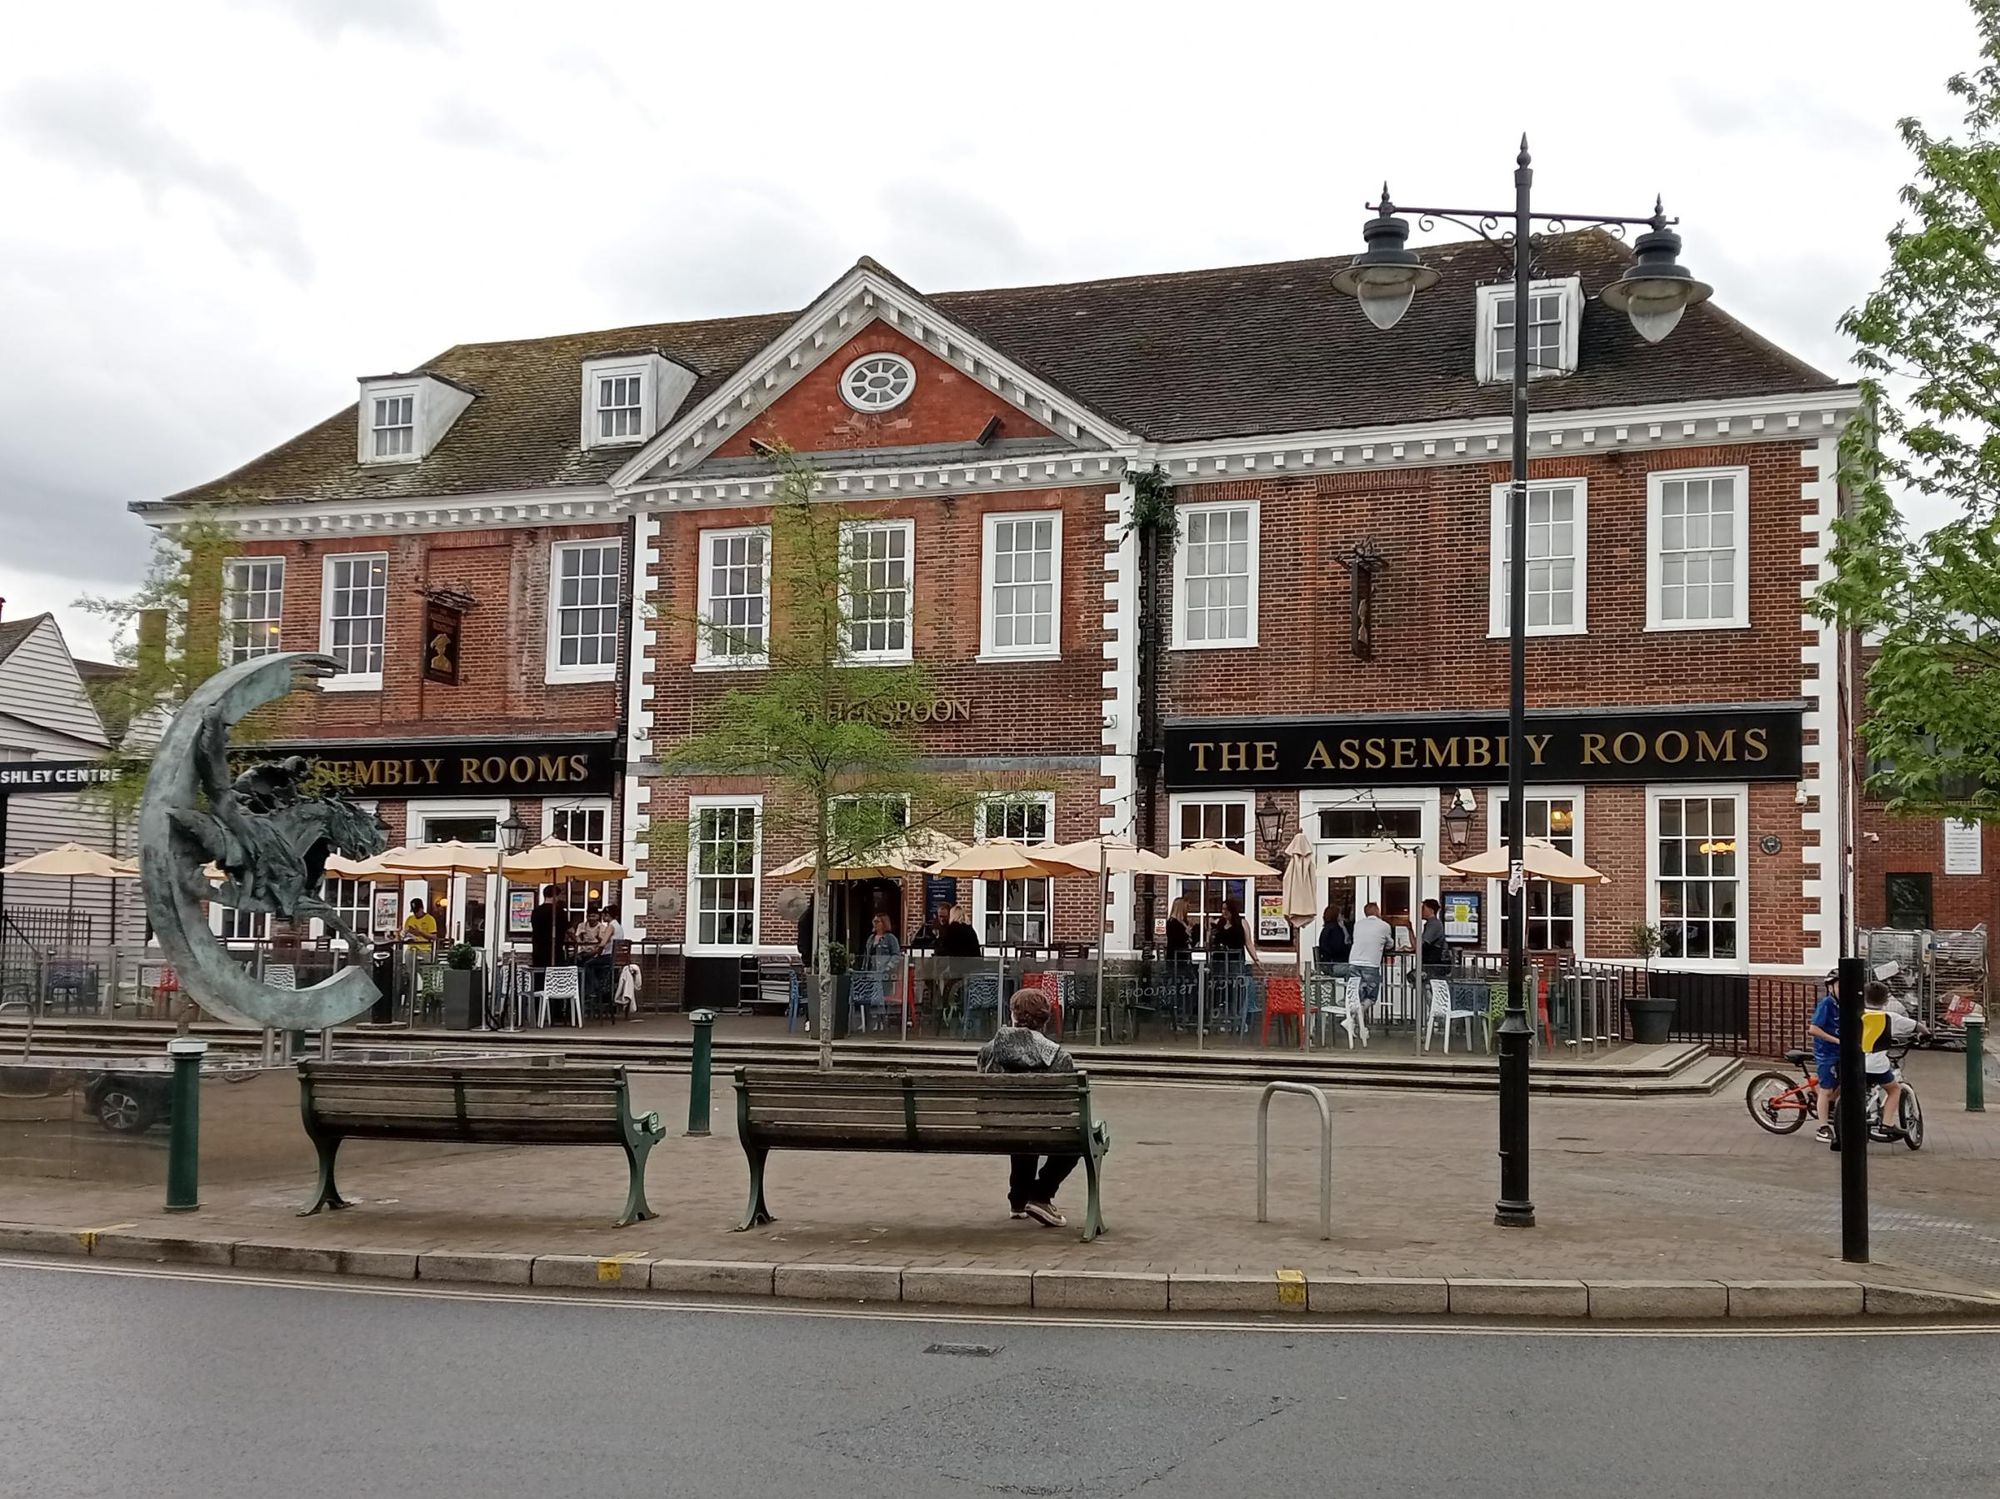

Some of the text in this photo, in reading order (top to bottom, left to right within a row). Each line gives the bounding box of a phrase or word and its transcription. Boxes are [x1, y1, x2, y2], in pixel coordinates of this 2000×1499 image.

[1189, 741, 1279, 772] THE
[1580, 728, 1769, 766] ROOMS
[55, 768, 123, 783] CENTRE
[315, 754, 589, 786] SEMBLY ROOMS
